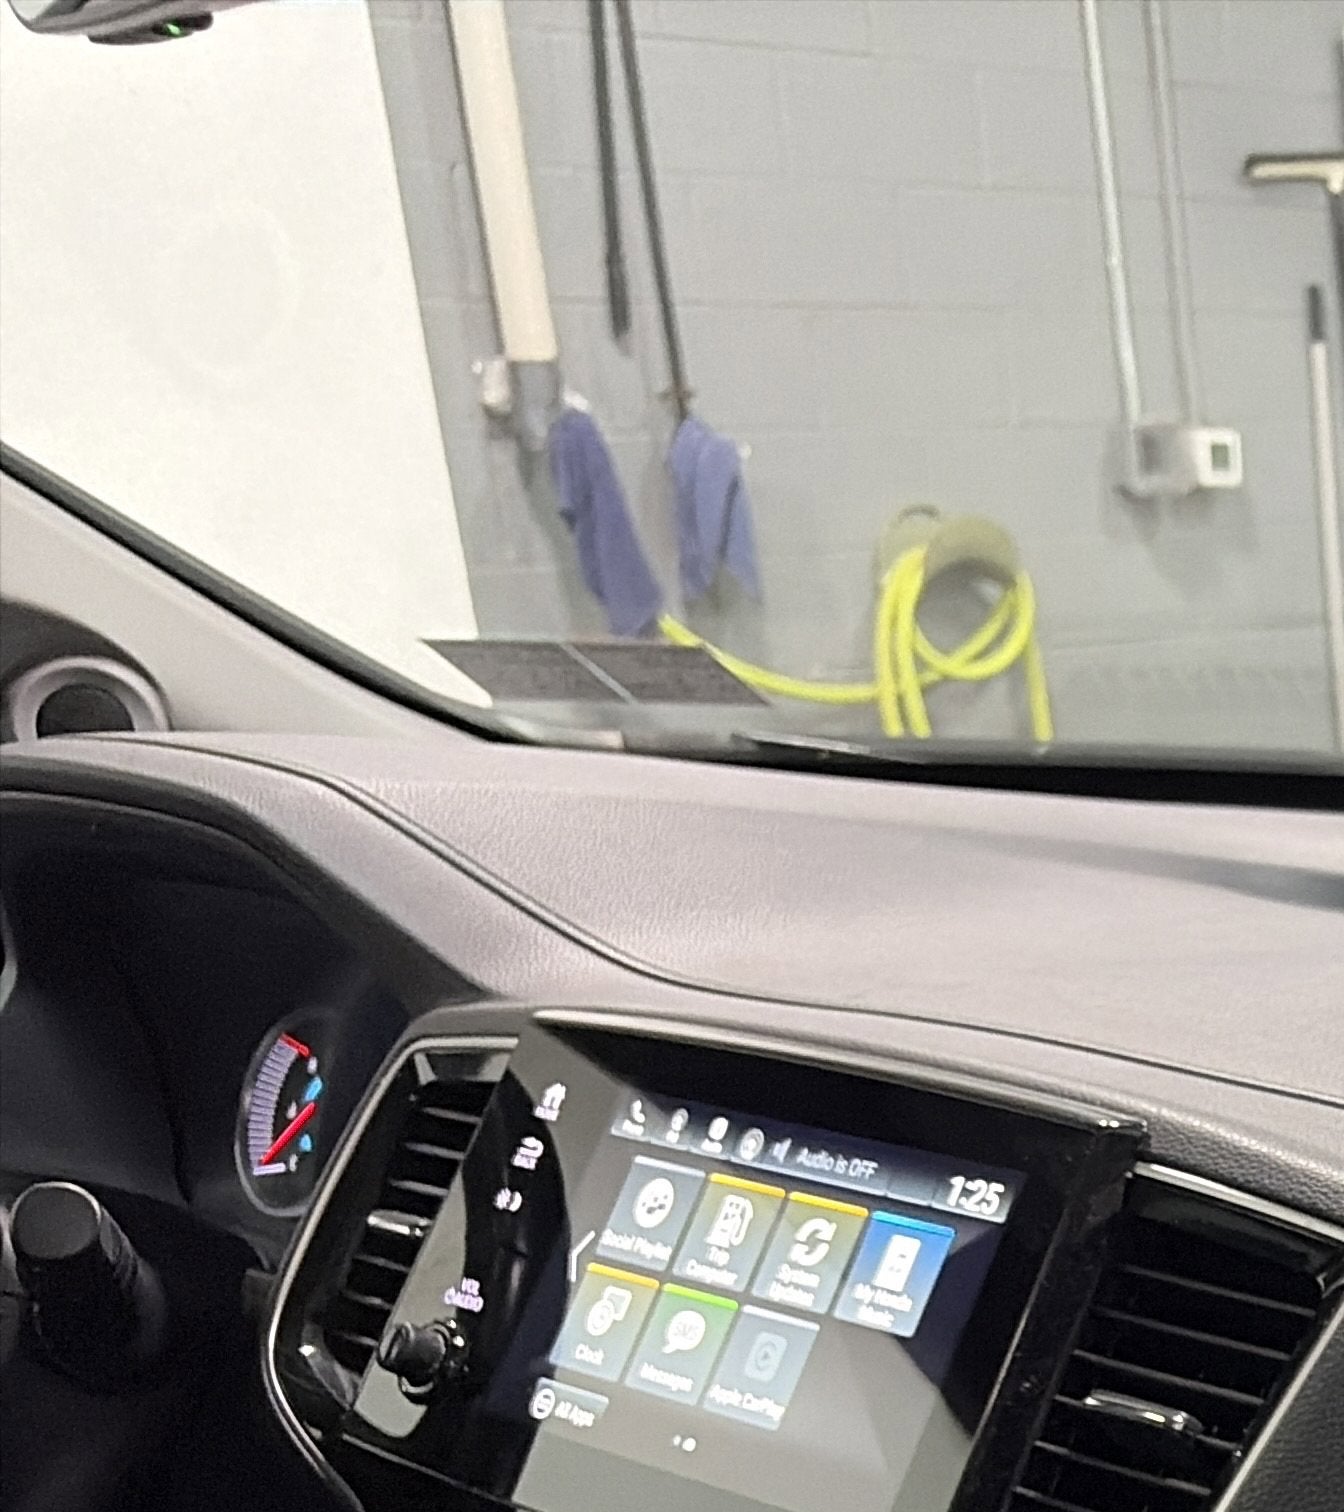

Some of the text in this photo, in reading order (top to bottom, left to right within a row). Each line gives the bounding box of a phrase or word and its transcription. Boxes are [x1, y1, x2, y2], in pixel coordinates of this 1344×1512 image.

[796, 1147, 879, 1179] Audio is OFF
[946, 1175, 1005, 1215] 1:25
[574, 1343, 604, 1365] Clock
[640, 1362, 694, 1393] Messages
[554, 1401, 595, 1427] All Apps
[708, 1383, 786, 1421] Apple CarPlay
